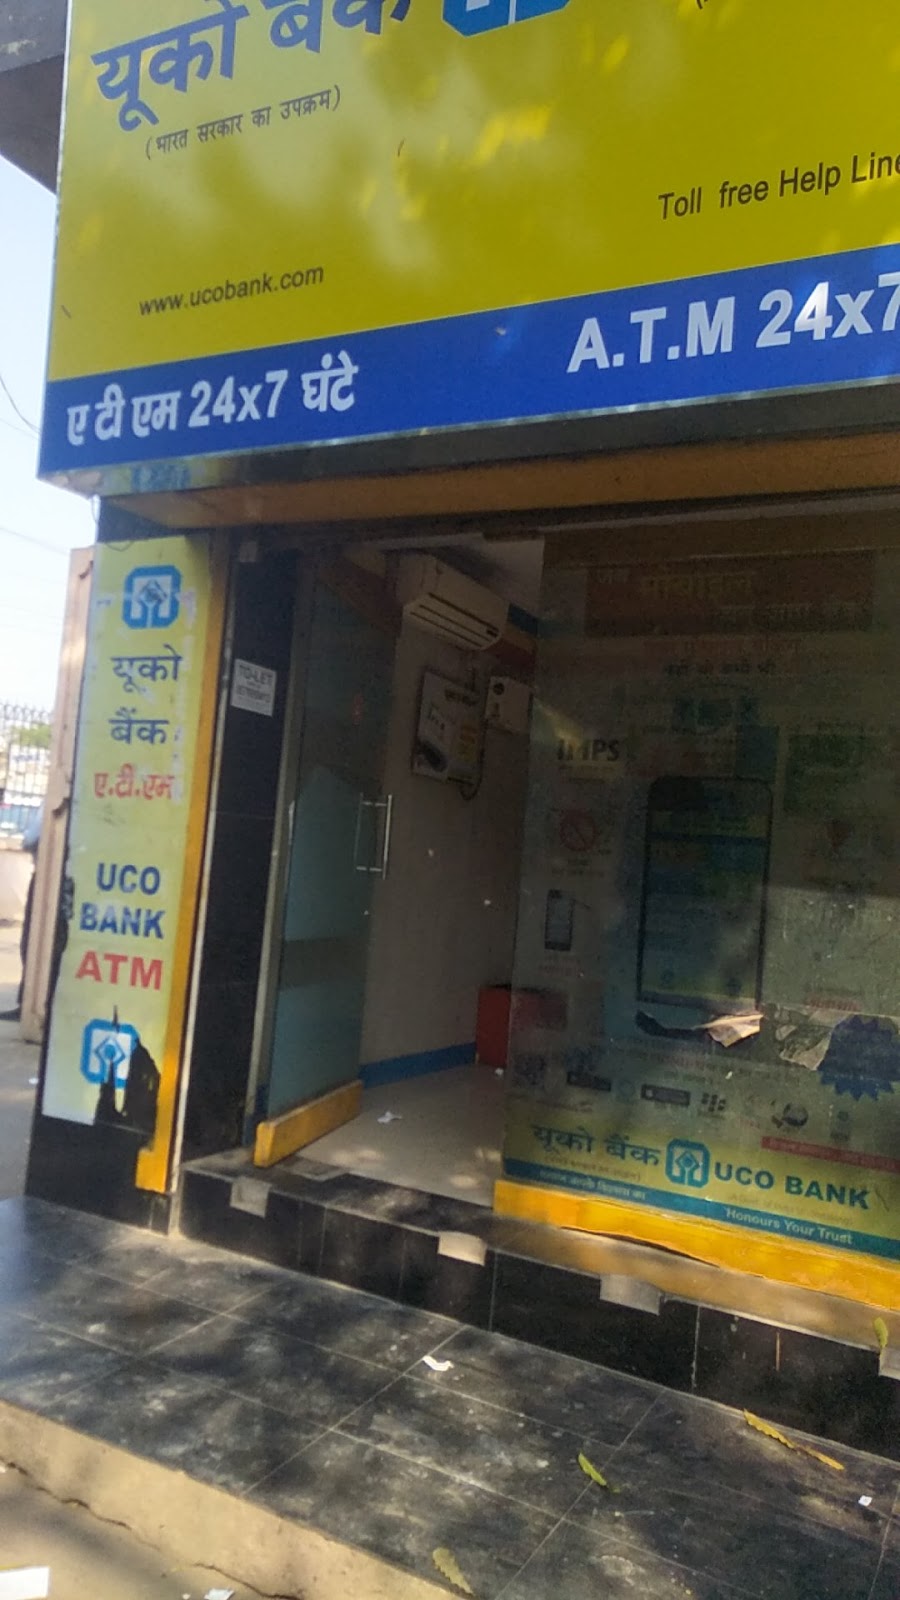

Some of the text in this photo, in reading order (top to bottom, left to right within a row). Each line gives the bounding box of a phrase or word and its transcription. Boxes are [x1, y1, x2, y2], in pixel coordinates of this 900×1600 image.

[91, 0, 250, 131] यूको
[196, 113, 244, 143] सरकार
[251, 106, 272, 128] का
[658, 187, 702, 220] Toll
[719, 180, 769, 208] free
[779, 162, 841, 196] Help
[139, 266, 324, 316] www.ucobank.com
[566, 271, 900, 373] A.T.M 24x7
[188, 370, 288, 427] 24x7
[301, 350, 359, 412] घंटे
[111, 643, 183, 693] यूको
[108, 706, 170, 745] बैंक
[96, 862, 160, 895] UCO
[79, 902, 166, 940] BANK
[75, 950, 163, 991] ATM
[531, 1123, 661, 1166] यूको बैंक
[714, 1160, 775, 1190] UCO
[784, 1174, 870, 1211] BANK
[724, 1206, 780, 1229] Honours
[783, 1219, 816, 1236] Your
[817, 1226, 854, 1245] Trust
